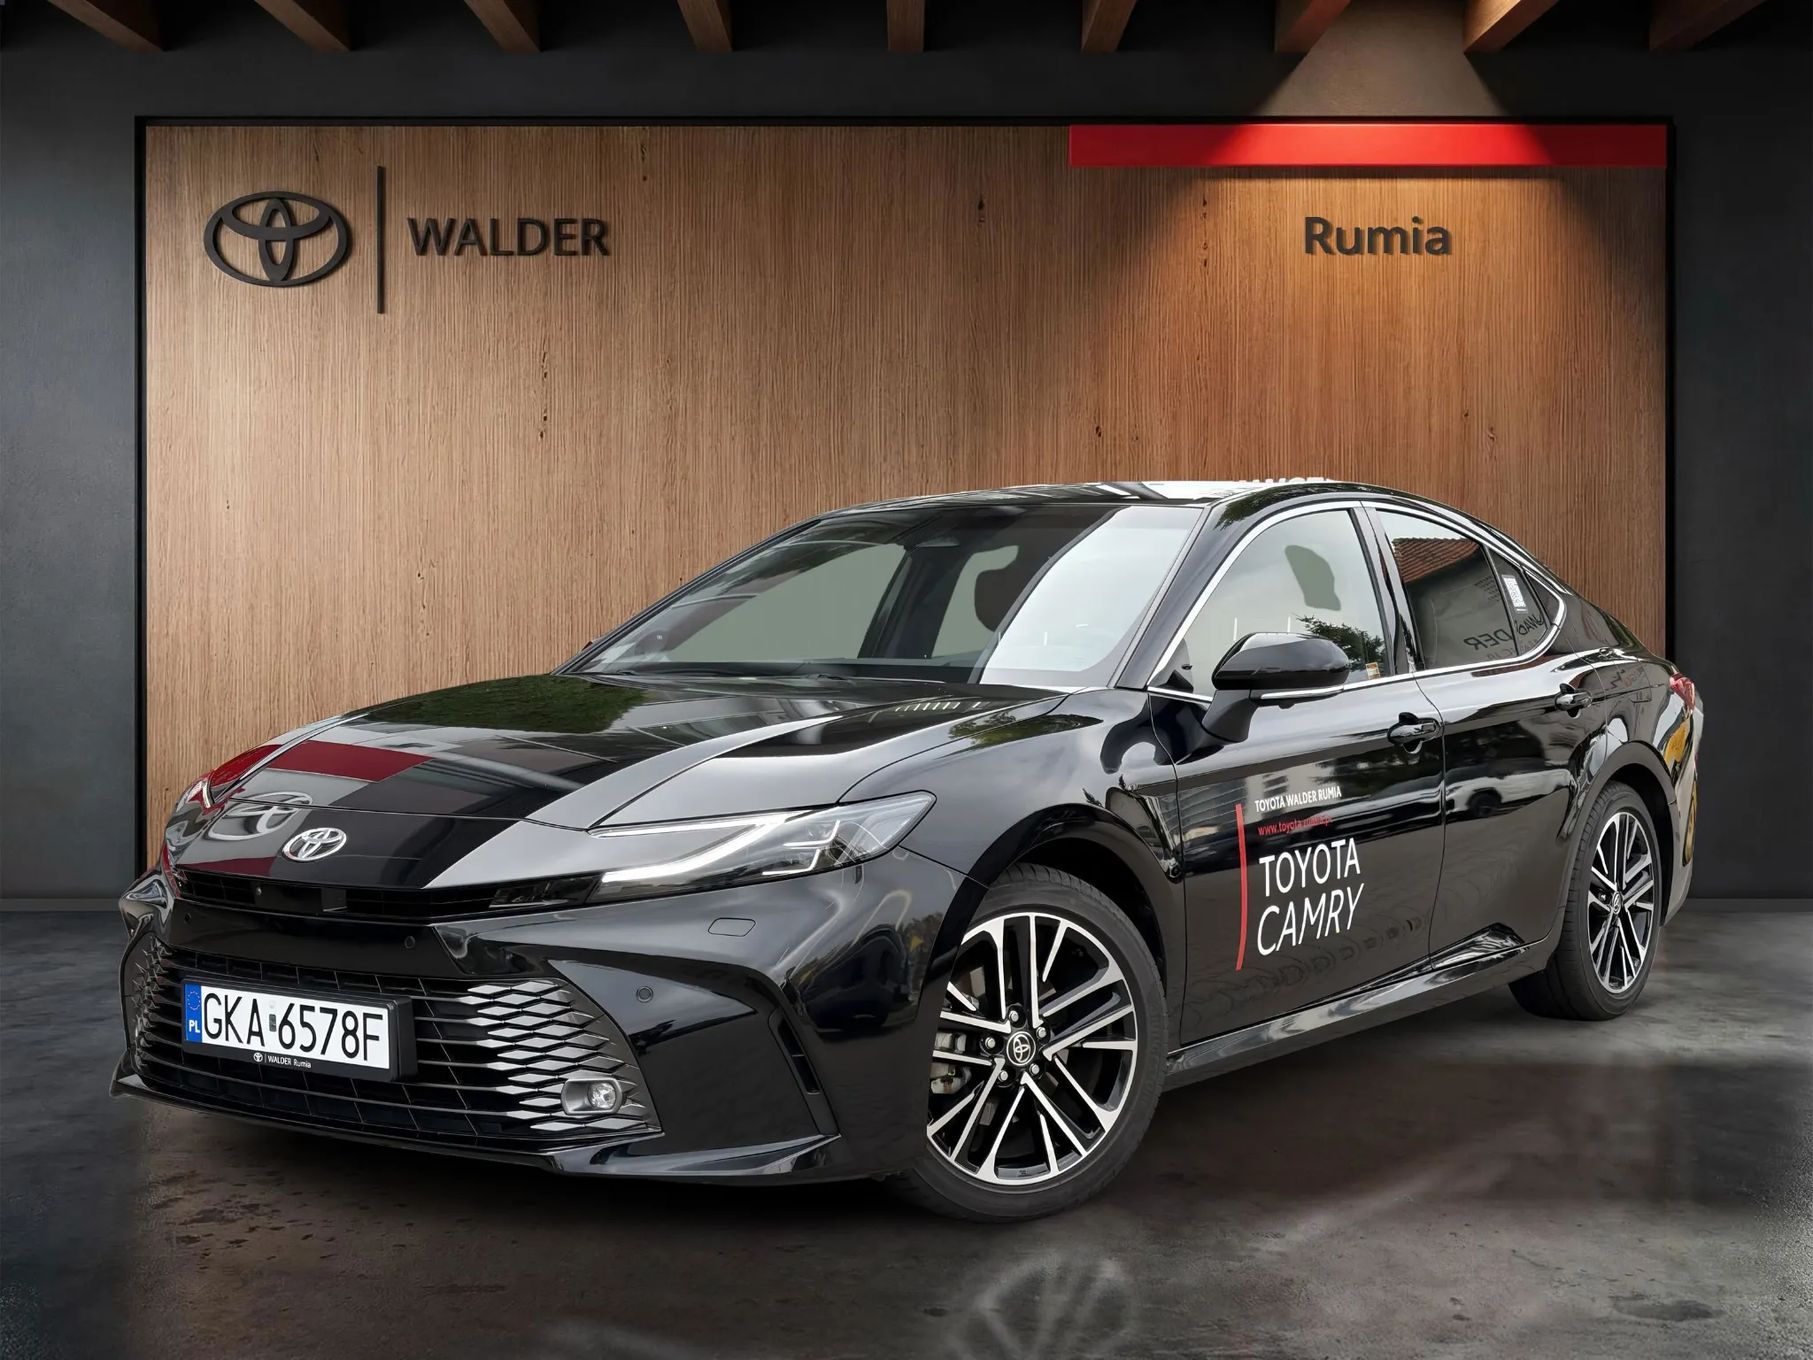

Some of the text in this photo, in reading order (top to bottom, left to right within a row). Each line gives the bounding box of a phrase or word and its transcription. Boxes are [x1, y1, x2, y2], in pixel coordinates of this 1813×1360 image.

[407, 217, 610, 256] WALDER
[1304, 216, 1452, 255] Rumia
[1254, 786, 1342, 812] TOYOTA WALDER RUMIA
[1258, 837, 1361, 897] TOYOTA
[1257, 883, 1365, 956] CAMRY
[188, 1019, 201, 1034] PL
[203, 992, 384, 1061] GKA 6578F
[267, 1055, 292, 1066] WALDER
